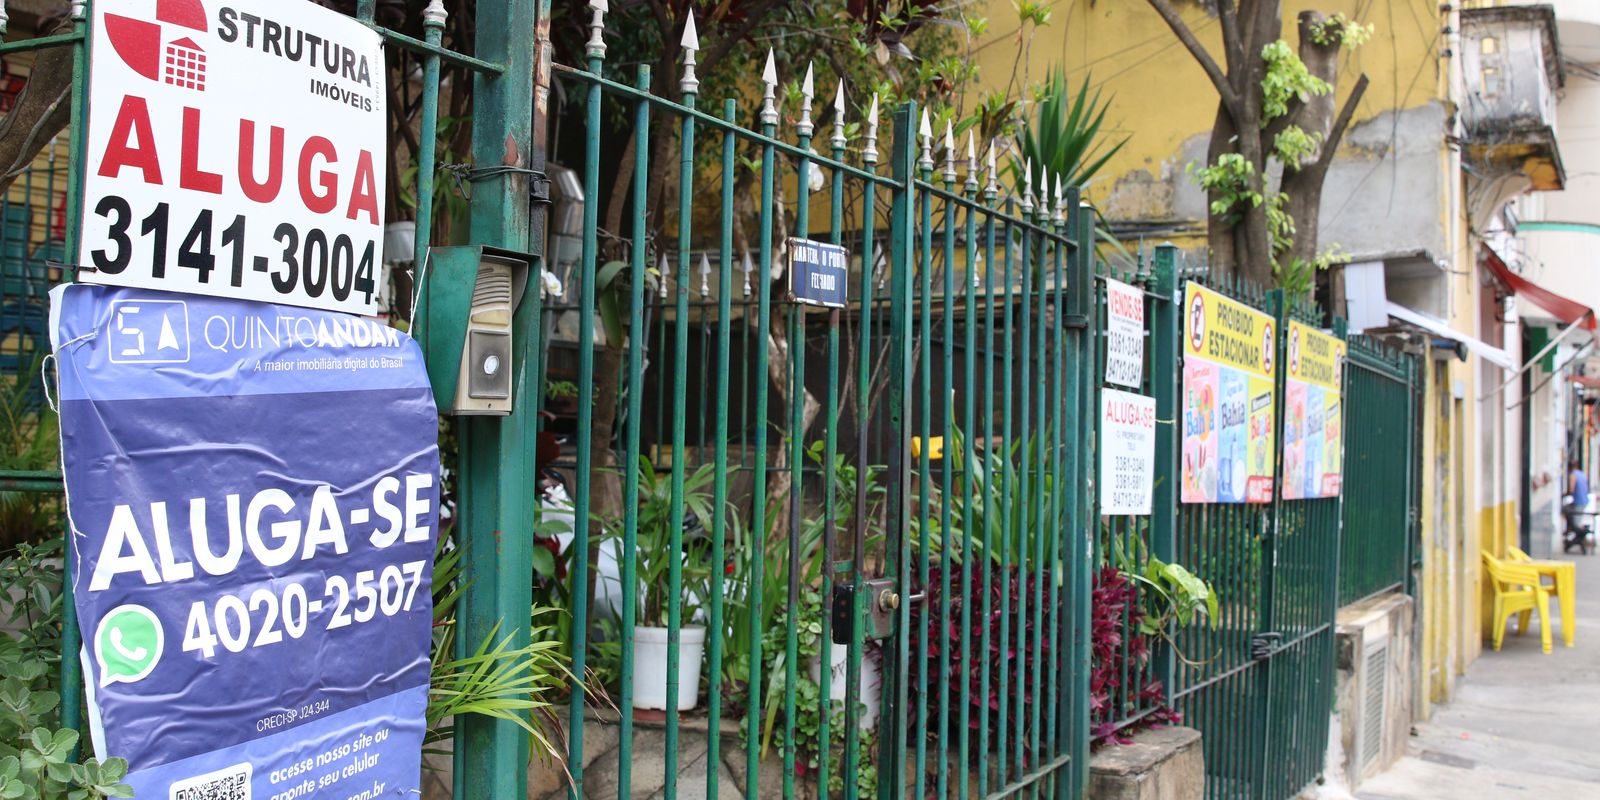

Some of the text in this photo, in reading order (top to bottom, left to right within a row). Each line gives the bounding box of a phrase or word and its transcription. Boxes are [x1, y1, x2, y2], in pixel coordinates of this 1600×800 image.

[217, 6, 372, 88] STRUTURA
[310, 78, 372, 113] IMÓVEIS
[97, 94, 380, 226] ALUGA
[90, 195, 375, 306] 3141-3004
[1109, 287, 1142, 322] VENDE-SE
[1217, 302, 1254, 337] PROIBIDO
[1209, 329, 1259, 369] ESTACIONAR
[1306, 332, 1330, 358] PROIBIDO
[254, 356, 403, 372] A maior imobiliária digital do Brasil
[1301, 355, 1332, 384] ESTACIONAR
[1106, 399, 1153, 429] ALUGA-SE
[88, 473, 433, 592] ALUGA-SE
[181, 560, 426, 659] 4020-2507
[256, 698, 330, 733] CRECI-SP J24.344
[270, 728, 389, 785] acesse nosso site ou
[270, 751, 380, 800] aponte seu celular
